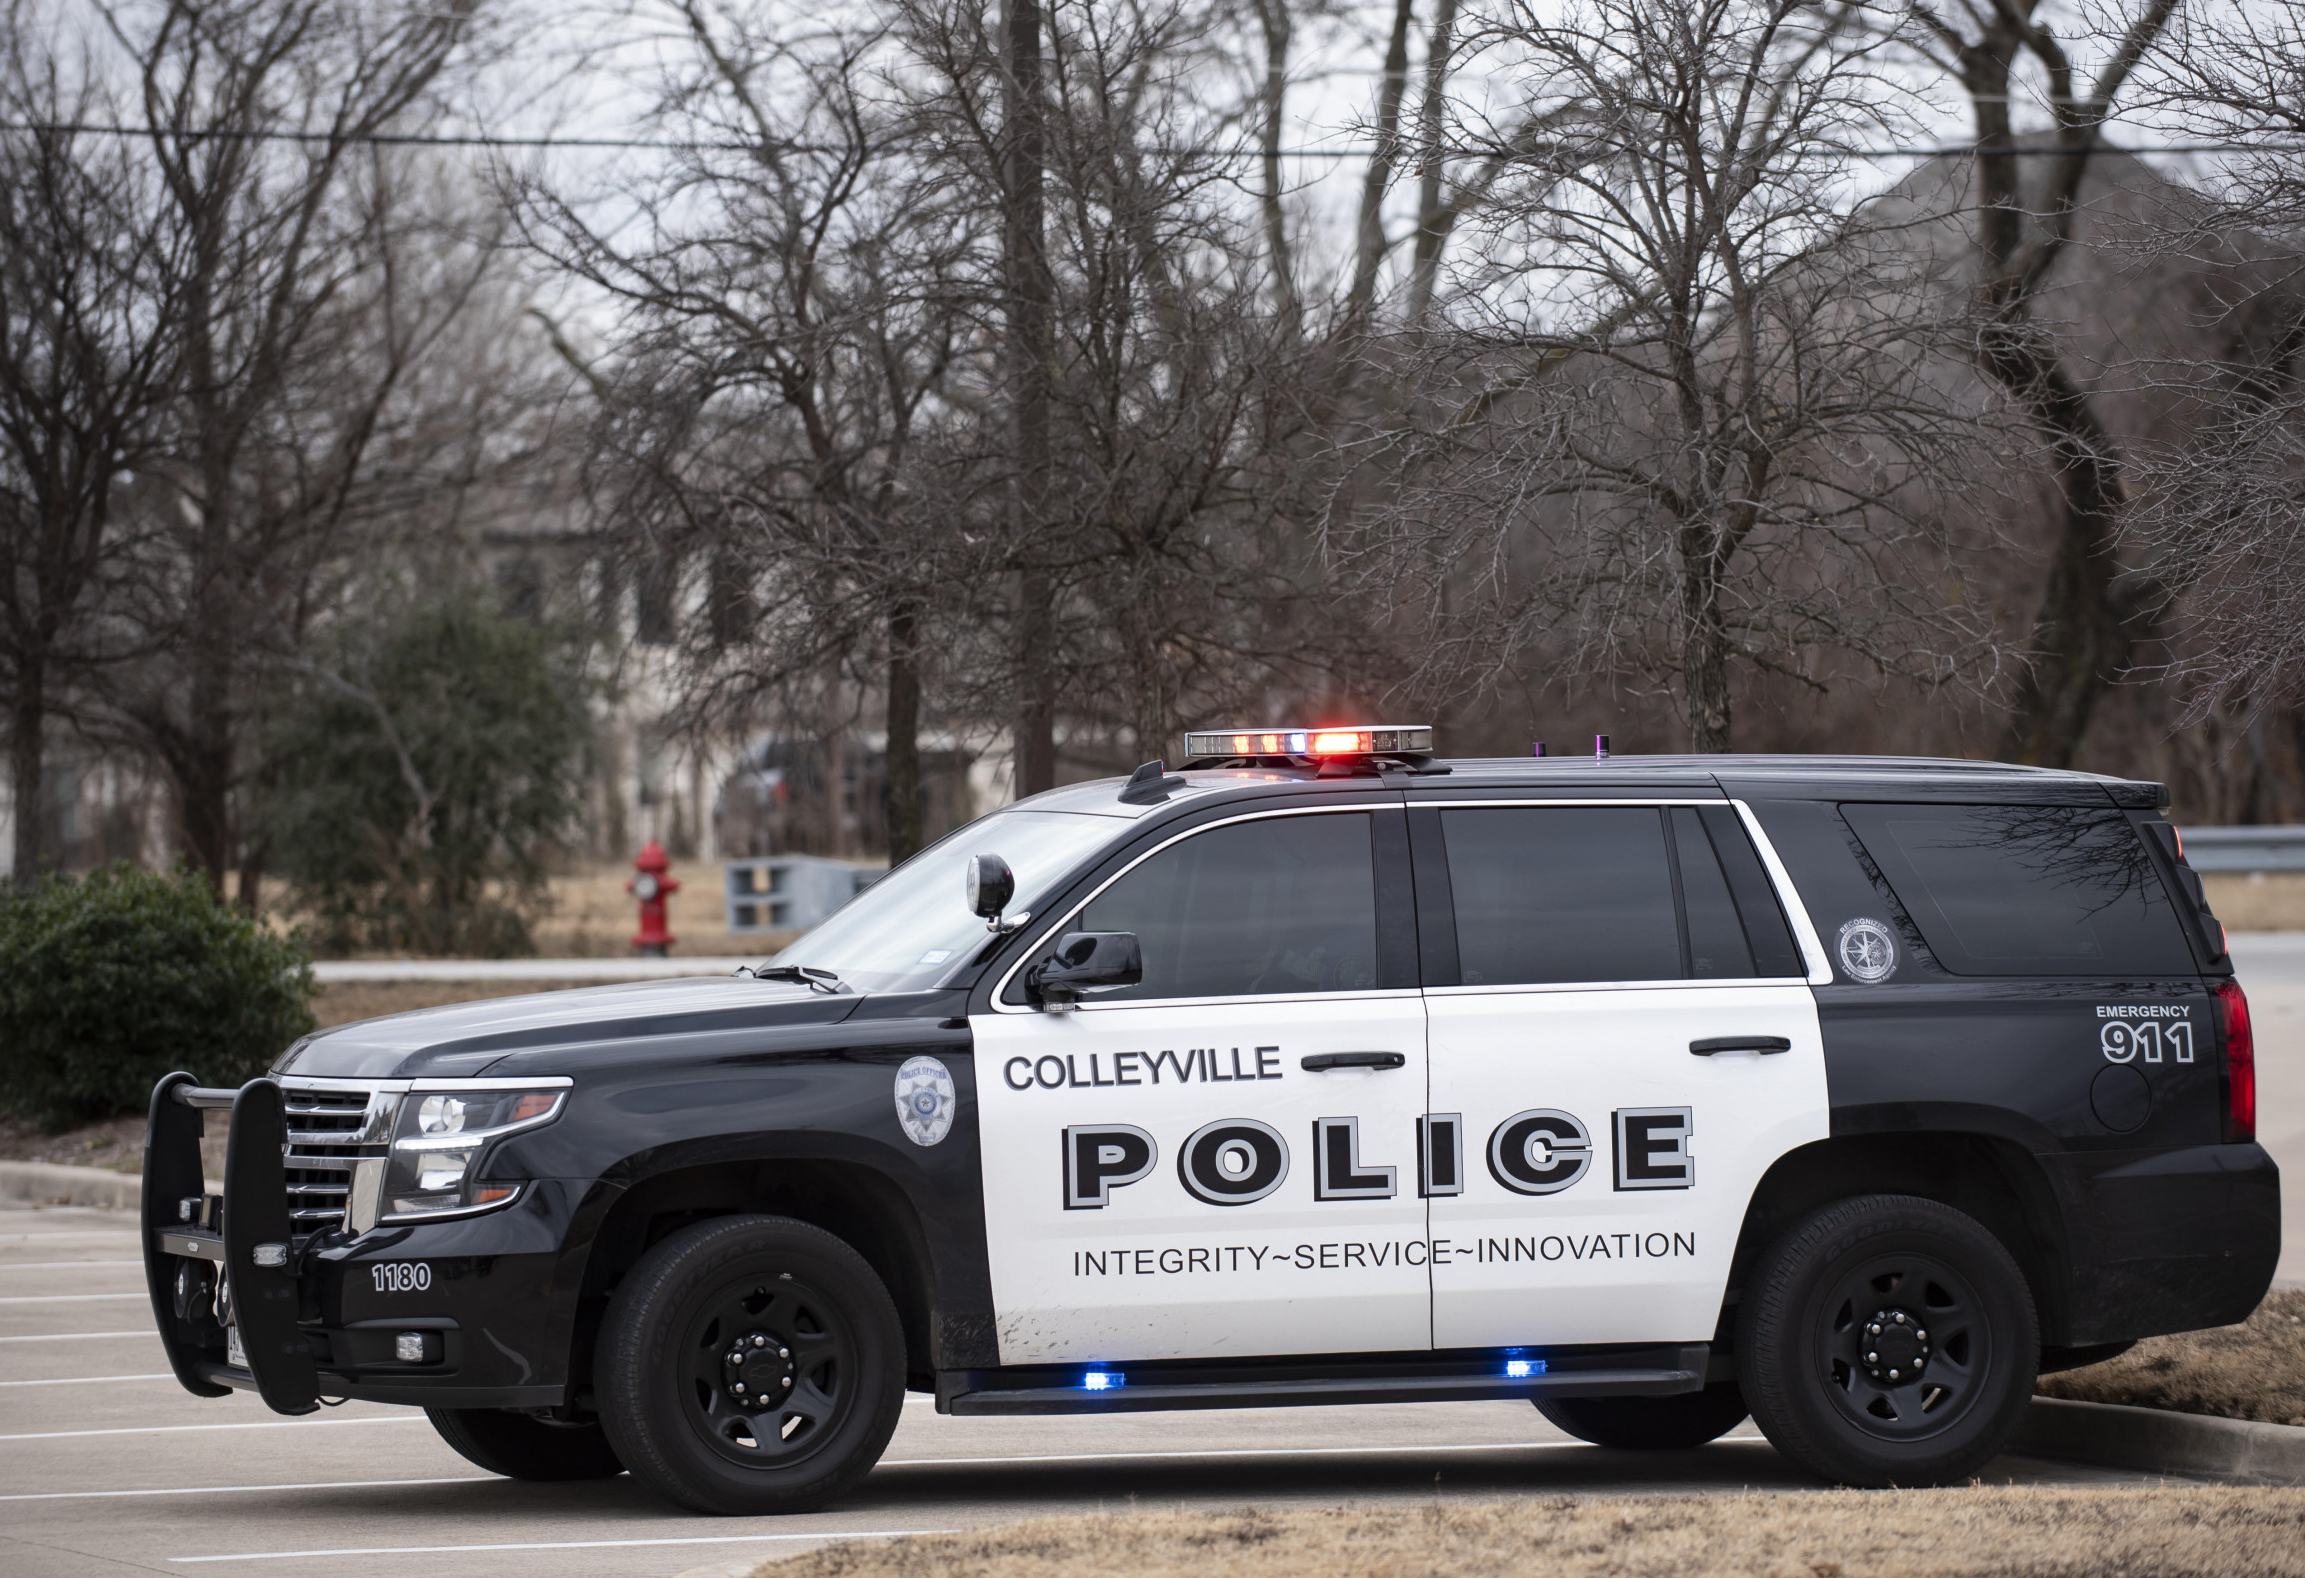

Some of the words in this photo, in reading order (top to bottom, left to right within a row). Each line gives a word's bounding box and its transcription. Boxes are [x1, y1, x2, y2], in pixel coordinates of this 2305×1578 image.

[1839, 918, 1888, 934] RECOGNIZED
[2096, 1005, 2190, 1018] EMERGENCY
[2100, 1020, 2194, 1064] 911
[901, 1067, 920, 1079] POLICE
[922, 1067, 946, 1079] OFFICER
[1003, 1046, 1283, 1091] COLLEYVILLE
[1062, 1106, 1695, 1210] POLICE
[371, 1262, 431, 1291] 1180
